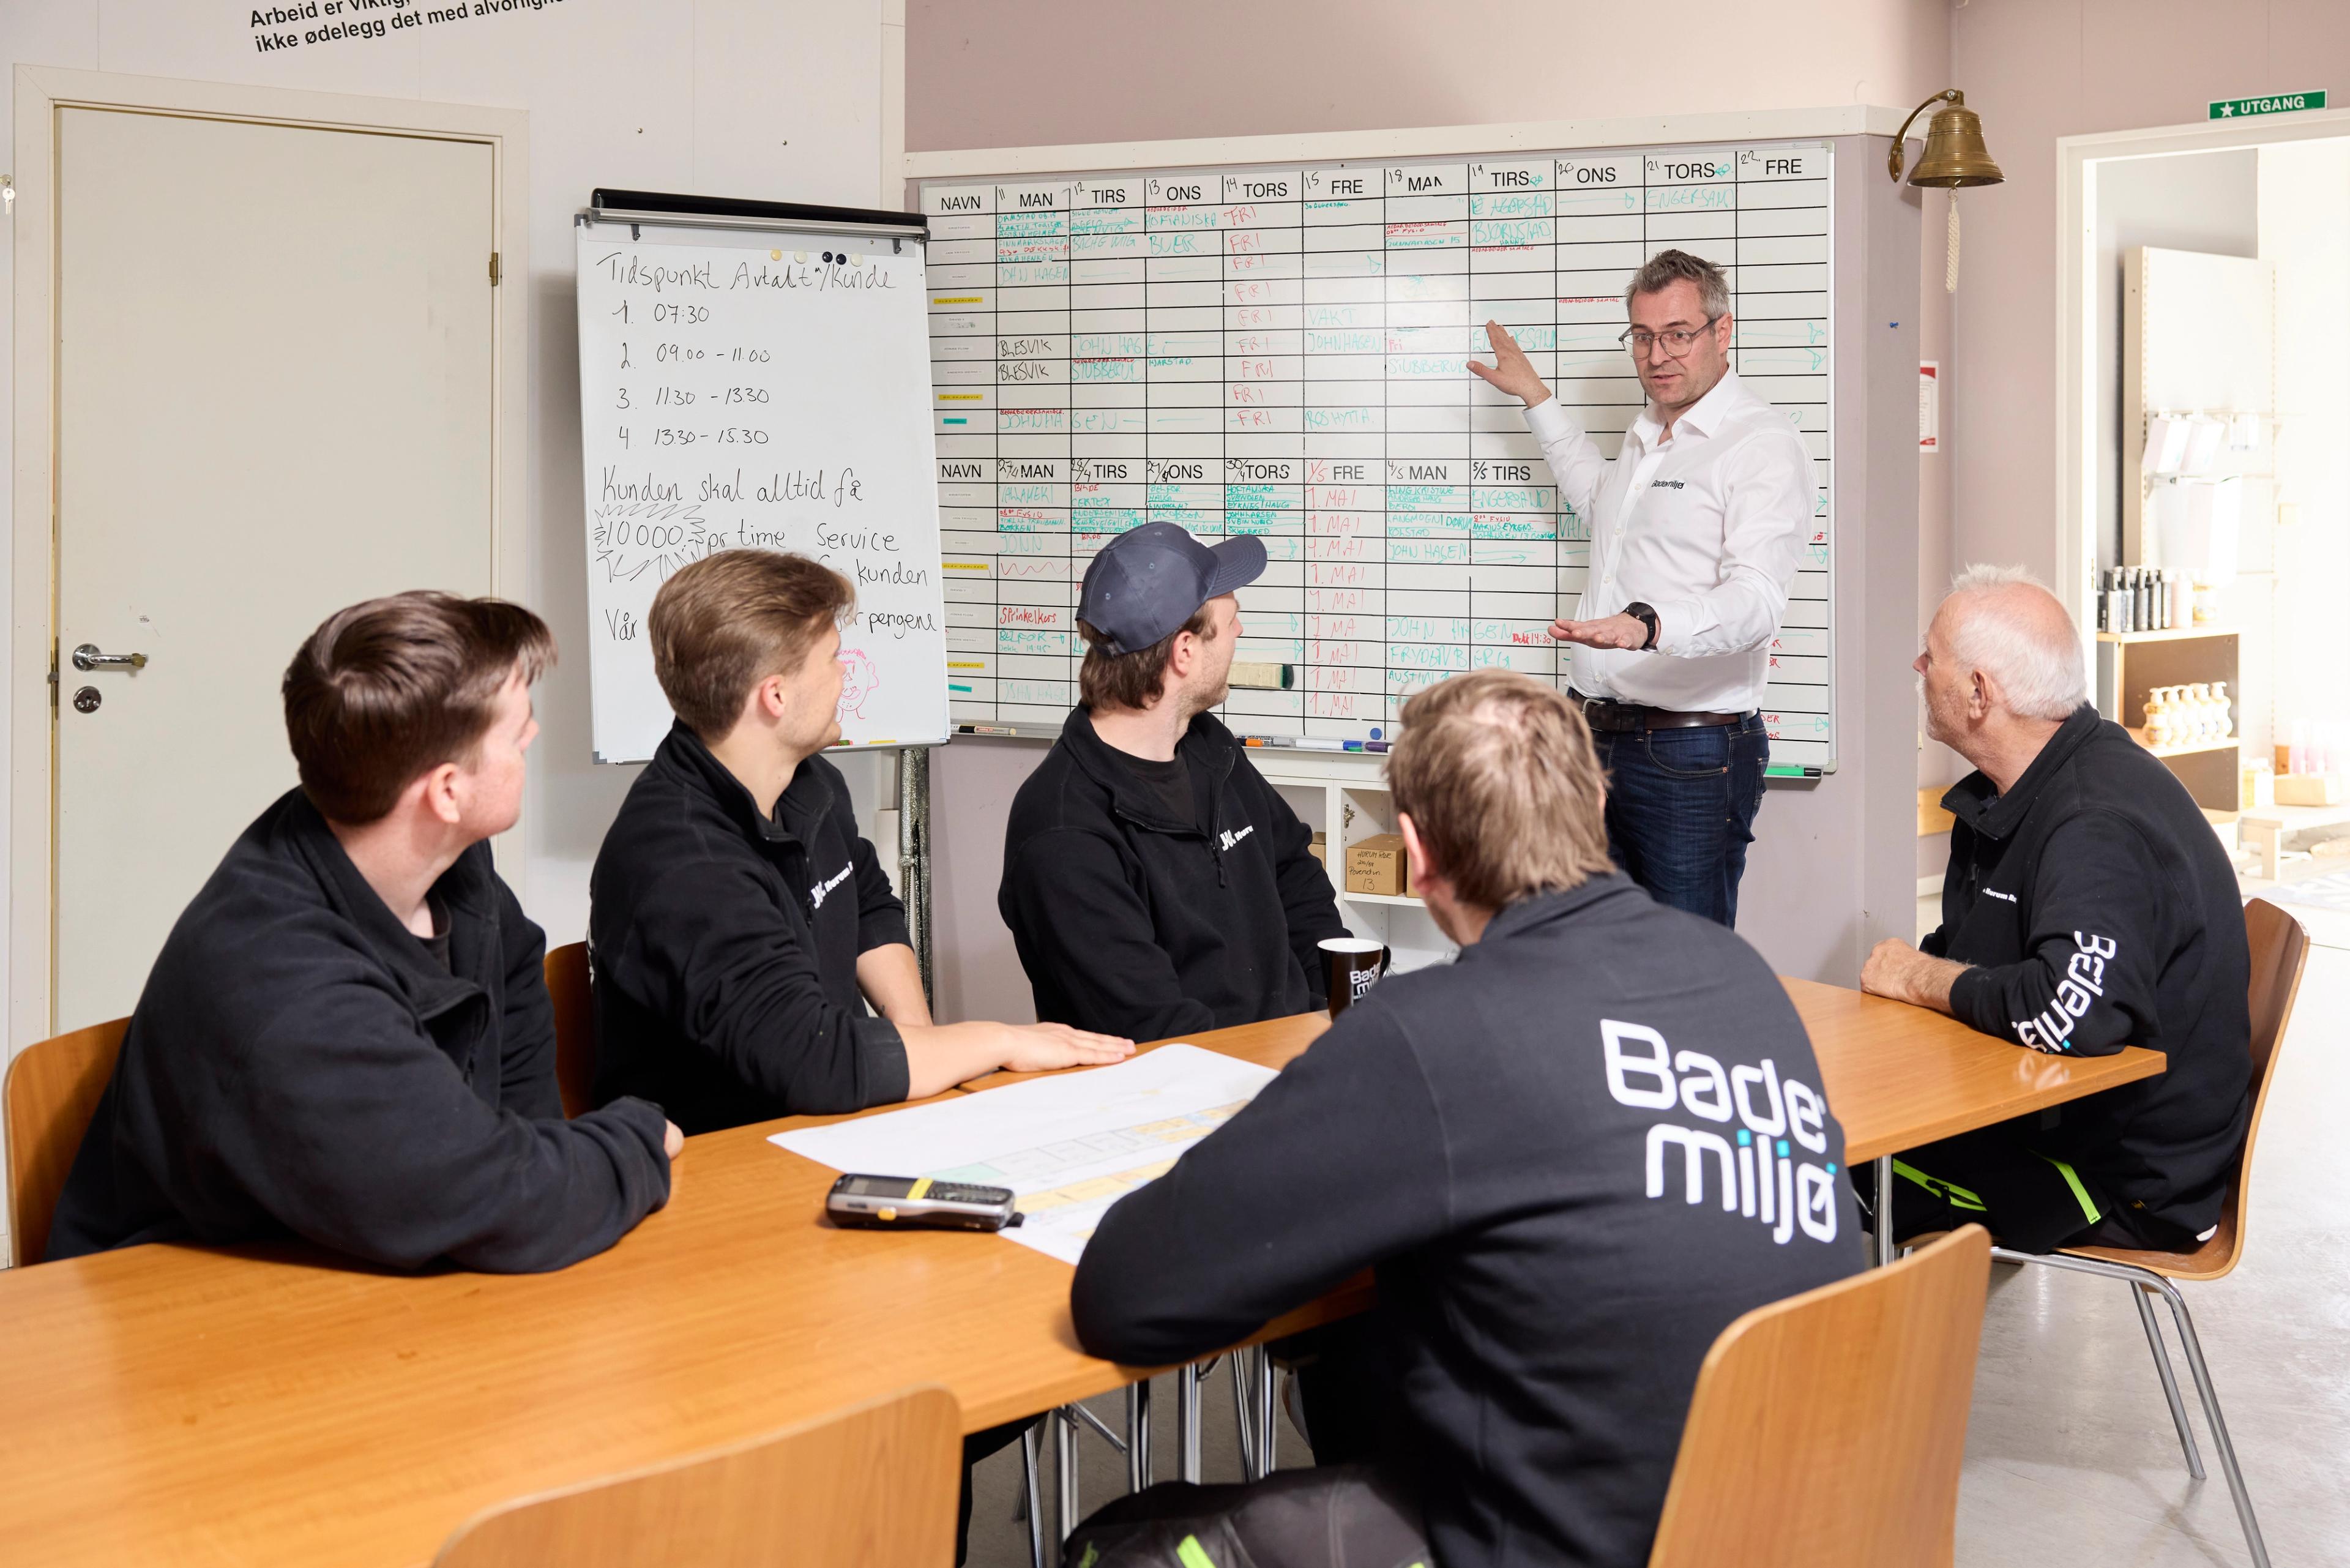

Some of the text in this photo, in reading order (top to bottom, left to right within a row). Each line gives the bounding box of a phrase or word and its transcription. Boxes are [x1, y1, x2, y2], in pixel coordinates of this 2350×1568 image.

[250, 2, 318, 28] Arbeid
[324, 0, 343, 16] er
[255, 32, 299, 53] ikke
[305, 18, 386, 45] ødelegg
[391, 12, 423, 29] det
[428, 6, 469, 24] med
[2240, 95, 2305, 115] UTGANG
[1472, 164, 1484, 177] 19
[1576, 167, 1617, 184] ONS
[1665, 162, 1715, 179] TORS
[1766, 159, 1803, 175] FRE
[1226, 177, 1238, 193] 14
[1305, 171, 1319, 190] 15
[1389, 169, 1403, 184] 18
[1408, 176, 1443, 192] MAN
[1491, 171, 1529, 187] TIRS
[1074, 182, 1085, 196] 12
[1149, 179, 1160, 195] 13
[1166, 185, 1201, 201] ONS
[1243, 182, 1288, 198] TORS
[1331, 179, 1363, 195] FRE
[941, 196, 980, 210] NAVN
[1020, 193, 1053, 207] MAN
[1092, 189, 1126, 204] TIRS
[1224, 206, 1256, 226] FRI
[1229, 233, 1261, 254] FRI
[1233, 254, 1265, 270] FRI
[597, 252, 720, 293] Tidspunkt
[730, 262, 813, 290] Avtalt
[1234, 282, 1271, 302] FRI
[612, 300, 710, 324] 1. 07:30
[1238, 309, 1272, 327] FRI
[1308, 308, 1357, 326] VAKT
[1239, 337, 1269, 353] FRI
[621, 343, 636, 370] 2.
[657, 343, 705, 363] 09.00
[1242, 360, 1274, 378] FRI
[616, 389, 638, 411] 3.
[655, 387, 696, 406] 11.30
[1233, 384, 1264, 403] FRI
[1237, 409, 1271, 426] FRI
[619, 427, 636, 450] 4.
[942, 465, 982, 478] NAVN
[1020, 465, 1054, 478] MAN
[1093, 465, 1127, 479] TIRS
[1169, 465, 1203, 479] ONS
[1245, 465, 1290, 479] TORS
[1334, 465, 1365, 480] FRE
[1409, 466, 1447, 480] MAN
[1473, 461, 1488, 480] 5/5
[1492, 466, 1531, 480] TIRS
[602, 465, 864, 508] Kunden skal alltid få
[1326, 489, 1356, 507] MAI
[1327, 515, 1360, 533] MAI
[737, 518, 786, 547] time
[817, 523, 900, 551] Service
[1327, 540, 1363, 557] MAI
[857, 558, 928, 587] kunden
[1330, 566, 1364, 584] MAI
[1332, 589, 1364, 610] MAI
[606, 609, 637, 641] Vår
[868, 612, 938, 640] pengene
[1329, 643, 1358, 665] MAI
[1327, 666, 1356, 690] MAI
[1329, 693, 1354, 717] MAI
[1363, 878, 1375, 891] 13
[1600, 1018, 1827, 1154] Bade
[1646, 1123, 1837, 1245] miljø
